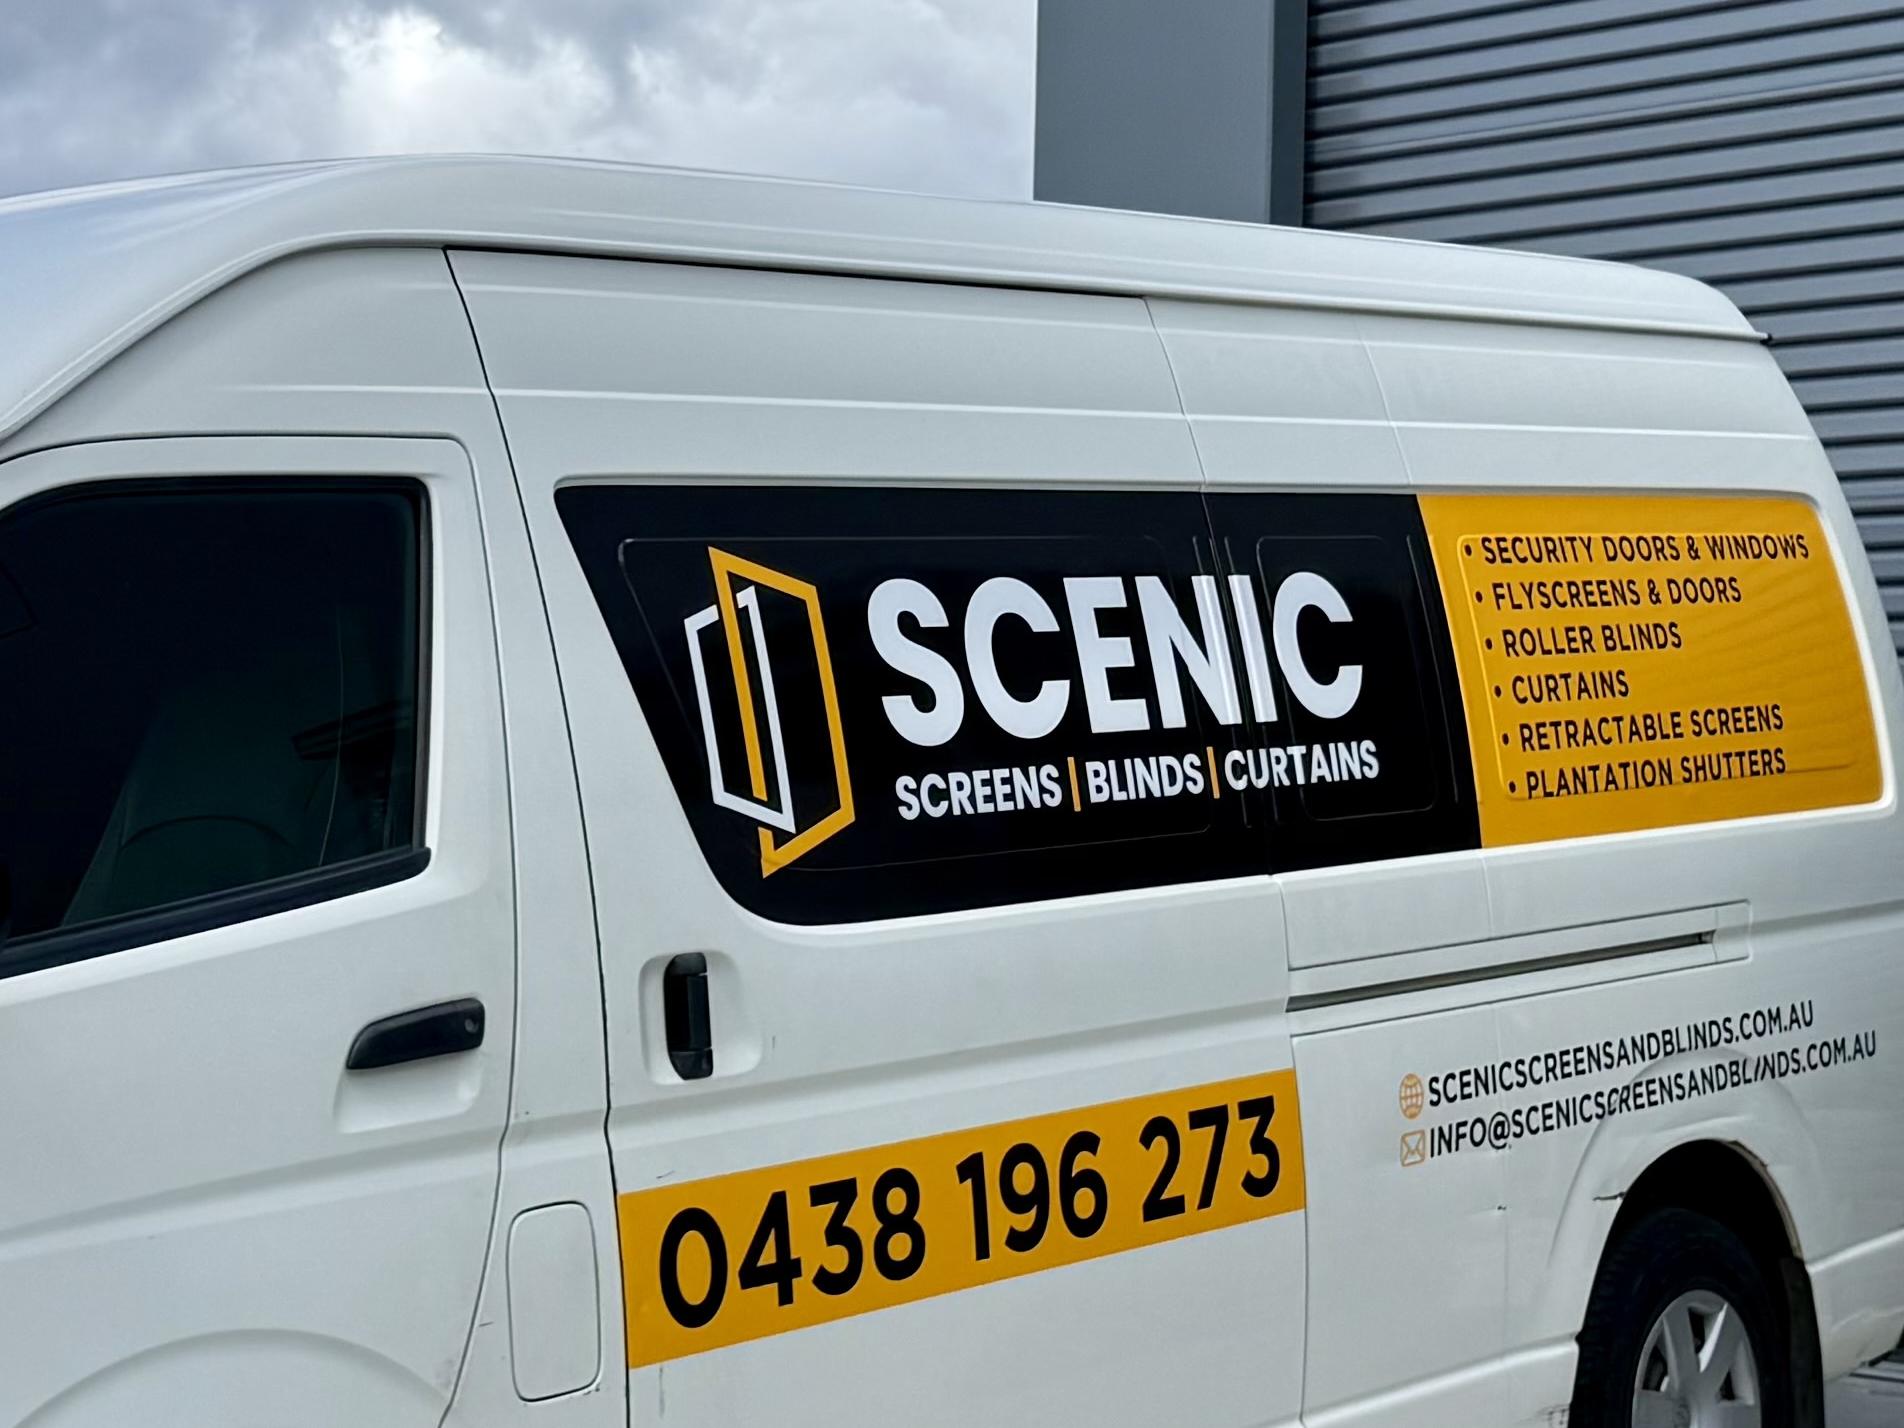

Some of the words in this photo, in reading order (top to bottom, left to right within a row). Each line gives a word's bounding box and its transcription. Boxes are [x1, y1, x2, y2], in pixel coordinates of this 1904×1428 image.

[1481, 536, 1595, 565] SECURITY
[1604, 536, 1682, 562] DOORS
[1686, 535, 1701, 560] &
[1703, 533, 1810, 560] WINDOWS
[1492, 578, 1641, 611] FLYSCREENS
[1647, 580, 1662, 605] &
[1667, 576, 1742, 605] DOORS
[866, 570, 1364, 747] SCENIC
[1501, 624, 1595, 658] ROLLER
[1603, 621, 1683, 652] BLINDS
[1512, 669, 1630, 705] CURTAINS
[1519, 710, 1685, 752] RETRACTABLE
[1690, 703, 1784, 738] SCREENS
[894, 766, 1062, 822] SCREENS
[1087, 752, 1205, 805] BLINDS
[1223, 738, 1381, 791] CURTAINS
[1525, 757, 1673, 799] PLANTATION
[1680, 747, 1787, 784] SHUTTERS
[1428, 1000, 1814, 1107] SCENICSCREENSANDBLINDS.COM.AU
[1428, 1030, 1878, 1159] INFO@SCENICSCREENSANDBLINDS.COM.AU
[659, 1167, 927, 1329] 0438
[955, 1129, 1109, 1263] 196
[1138, 1093, 1282, 1223] 273
